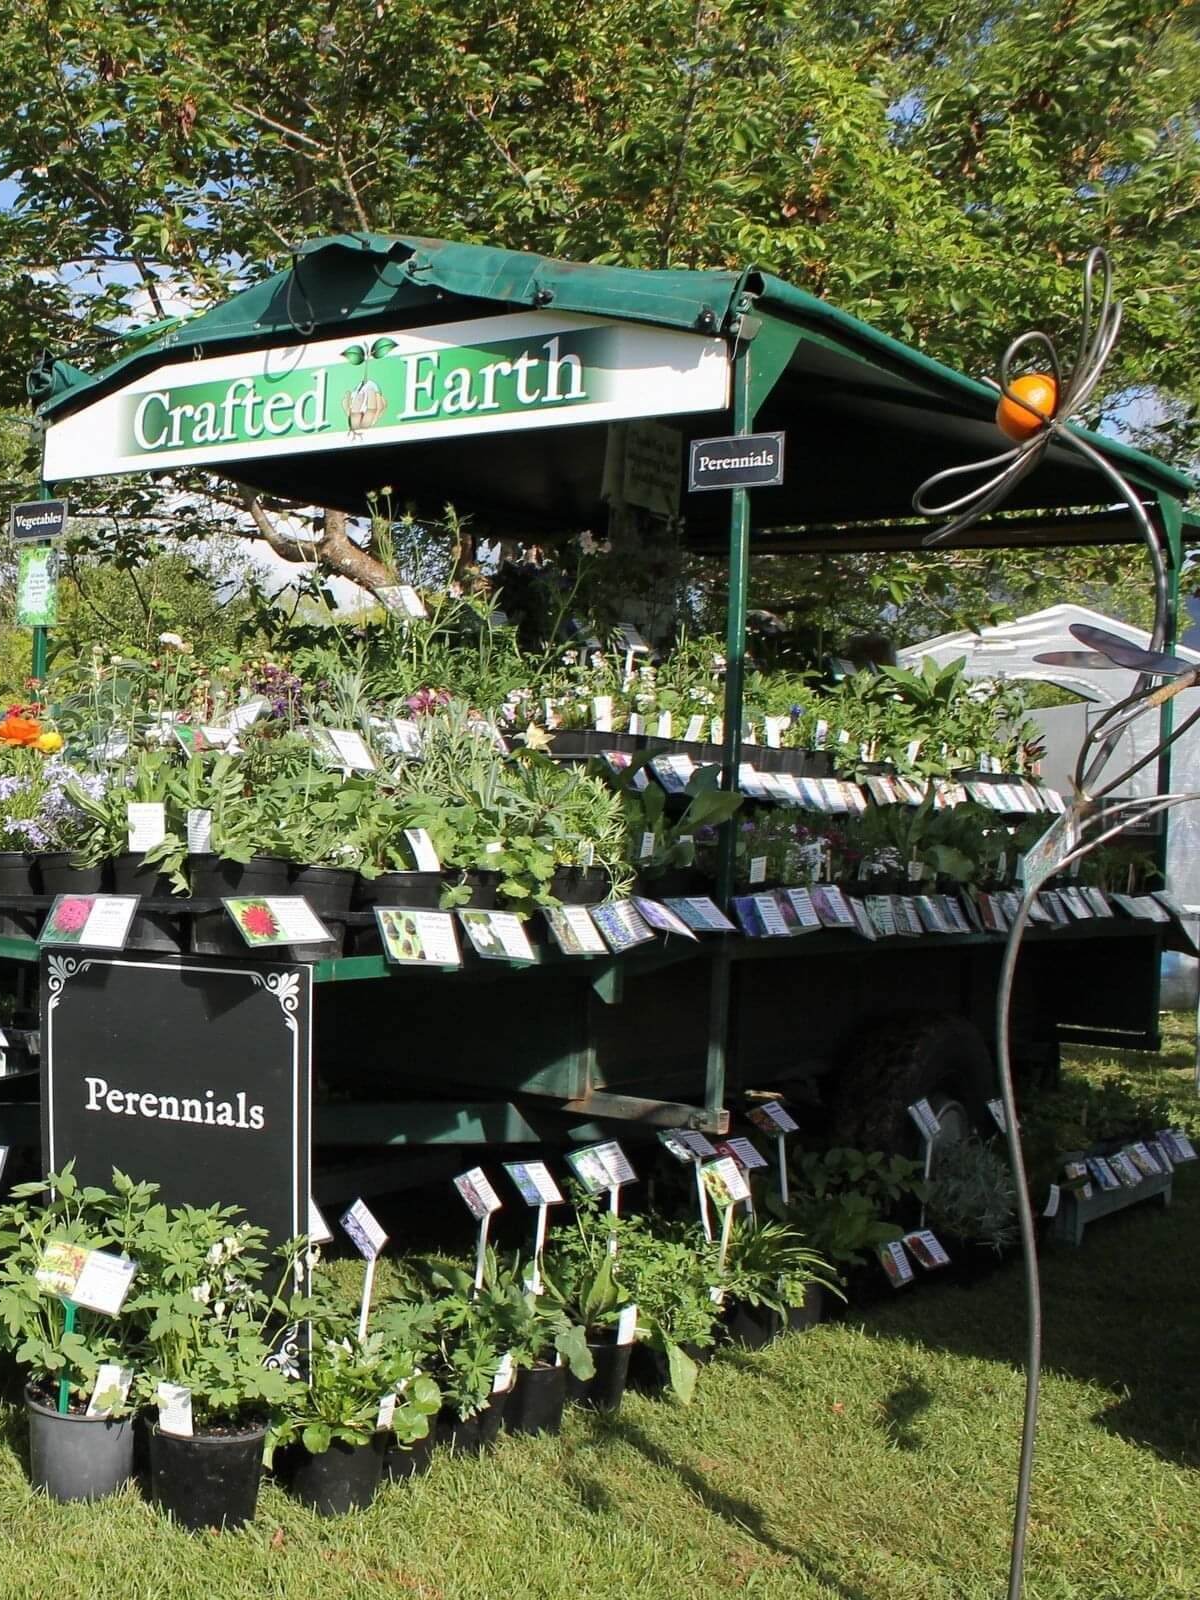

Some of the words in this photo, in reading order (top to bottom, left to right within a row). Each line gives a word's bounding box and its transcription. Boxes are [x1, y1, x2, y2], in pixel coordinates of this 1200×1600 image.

[134, 368, 330, 450] Crafted
[397, 336, 587, 421] Earth
[699, 450, 774, 471] Perennials
[15, 512, 62, 530] Vegetables
[85, 1077, 265, 1130] Perennials
